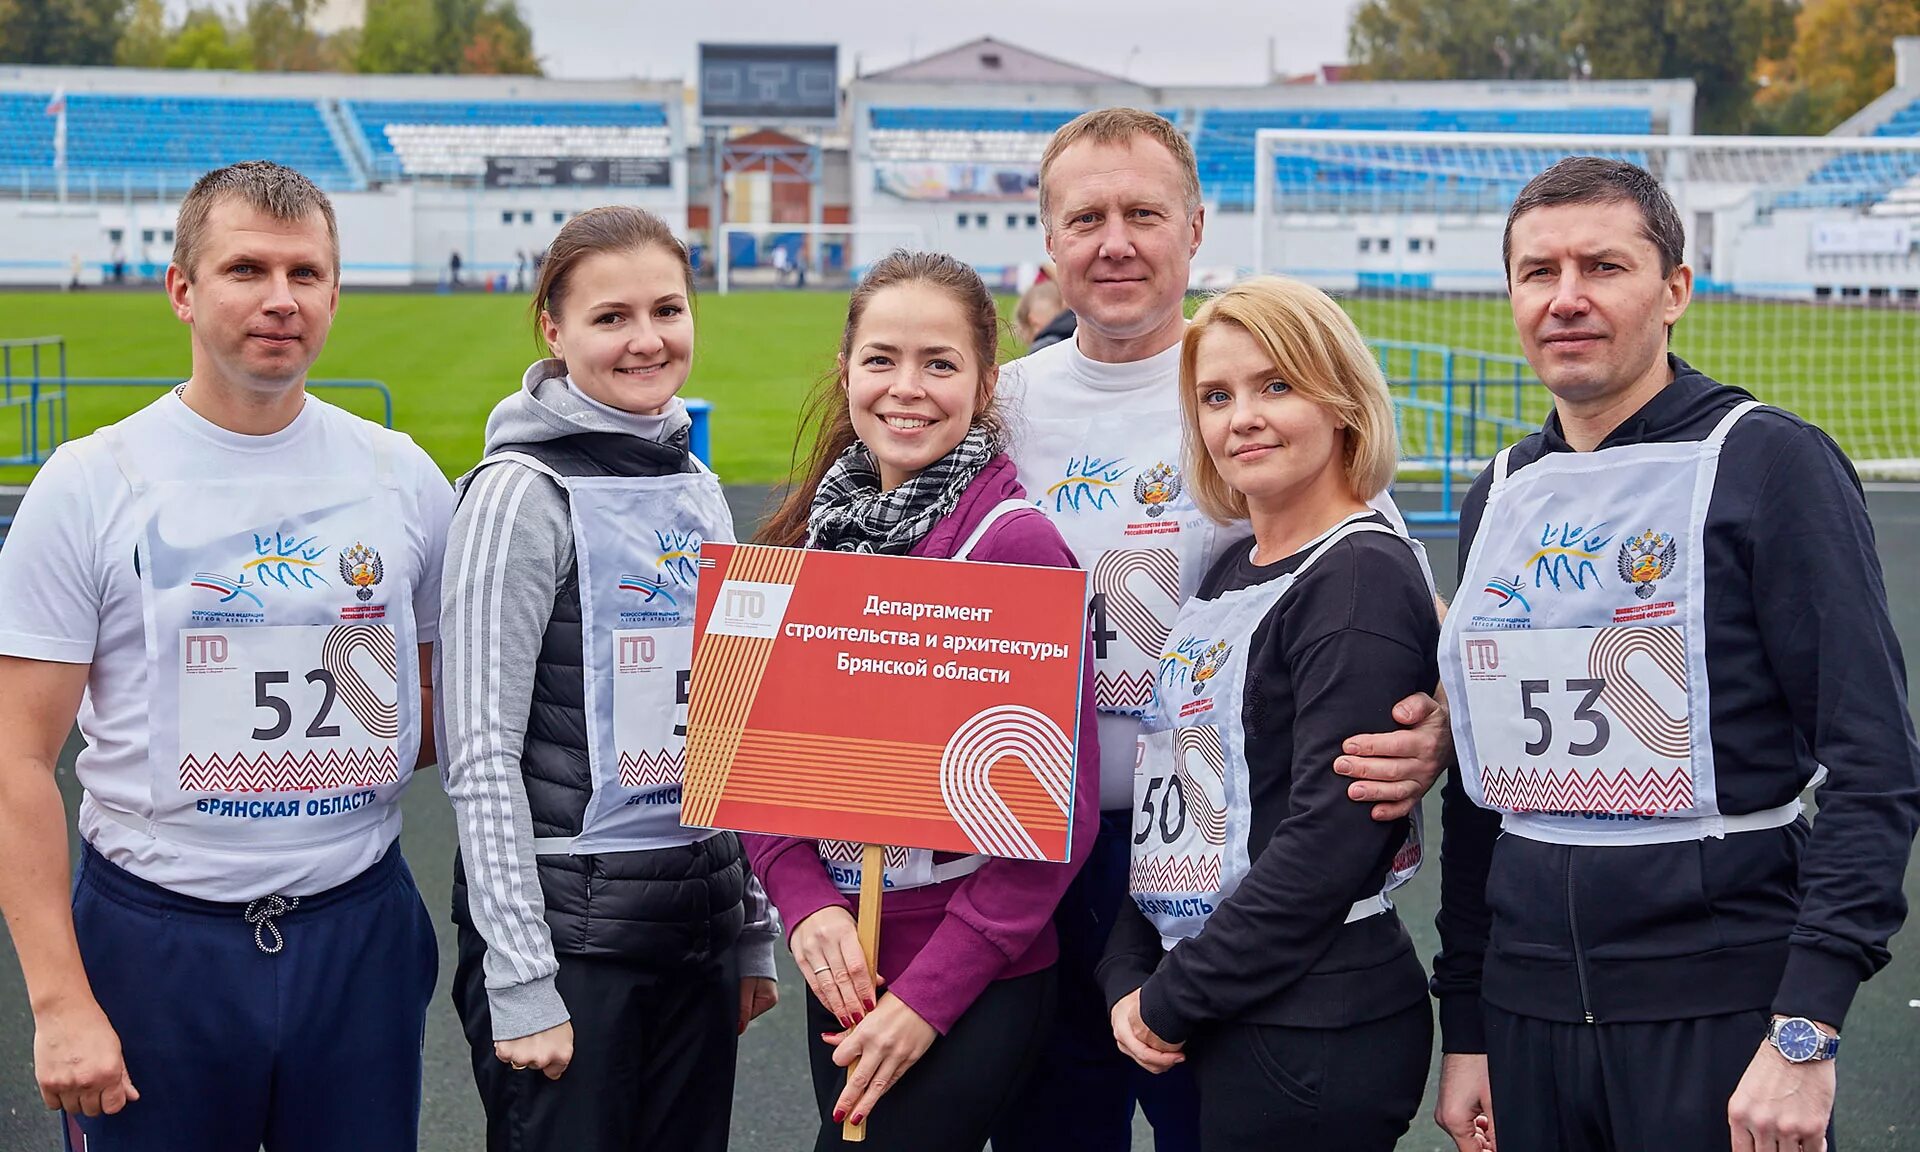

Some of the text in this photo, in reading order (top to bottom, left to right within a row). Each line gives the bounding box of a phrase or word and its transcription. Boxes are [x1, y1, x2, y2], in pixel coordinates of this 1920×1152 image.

[863, 595, 993, 622] Департамент
[186, 635, 228, 664] ГТО
[620, 635, 655, 664] ГТО
[785, 622, 920, 647] строительства
[925, 632, 938, 648] и
[942, 633, 1069, 662] архитектуры
[1465, 639, 1499, 670] ГТО
[836, 652, 1010, 684] Брянской области
[251, 668, 341, 741] 52
[1520, 678, 1611, 756] 53
[196, 789, 376, 819] БРЯНСКАЯ ОБЛАСТЬ
[1133, 773, 1187, 845] 50
